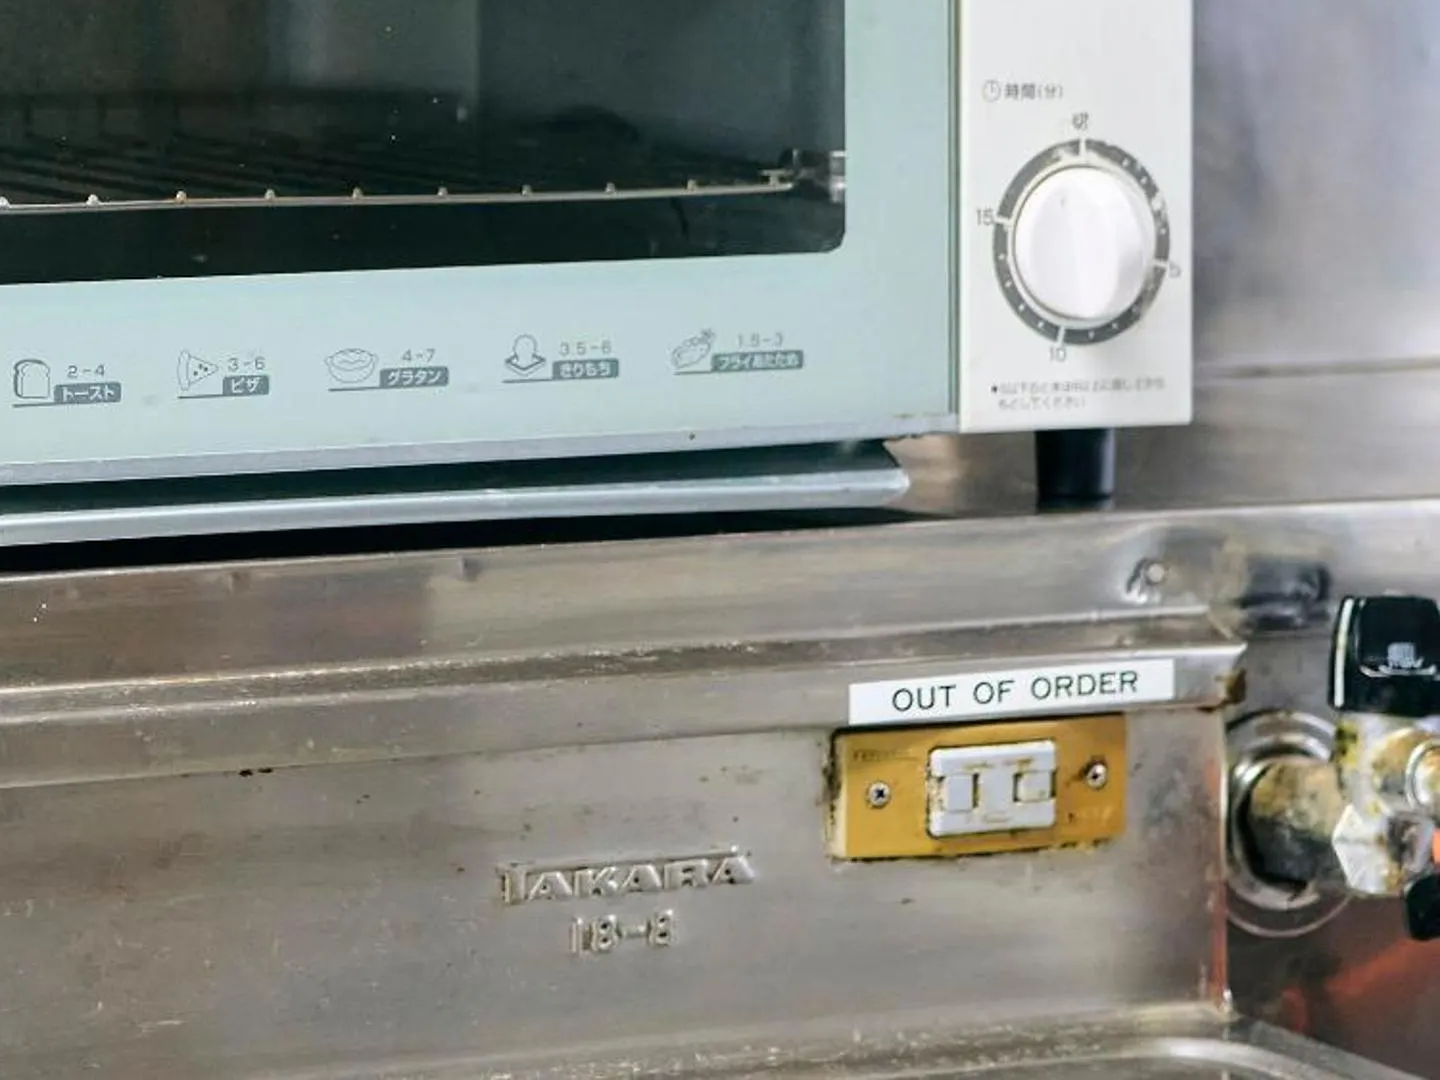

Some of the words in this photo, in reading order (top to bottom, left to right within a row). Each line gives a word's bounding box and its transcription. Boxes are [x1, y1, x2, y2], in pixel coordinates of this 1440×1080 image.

[400, 348, 435, 362] 4-7
[1049, 347, 1066, 362] 10
[67, 364, 105, 379] 2-4
[387, 369, 441, 386] グラタン
[62, 384, 115, 402] トースト
[231, 376, 261, 393] ピザ
[892, 684, 957, 712] OUT
[973, 679, 1015, 705] OF
[1031, 670, 1139, 700] ORDER
[497, 848, 755, 904] TAKARA
